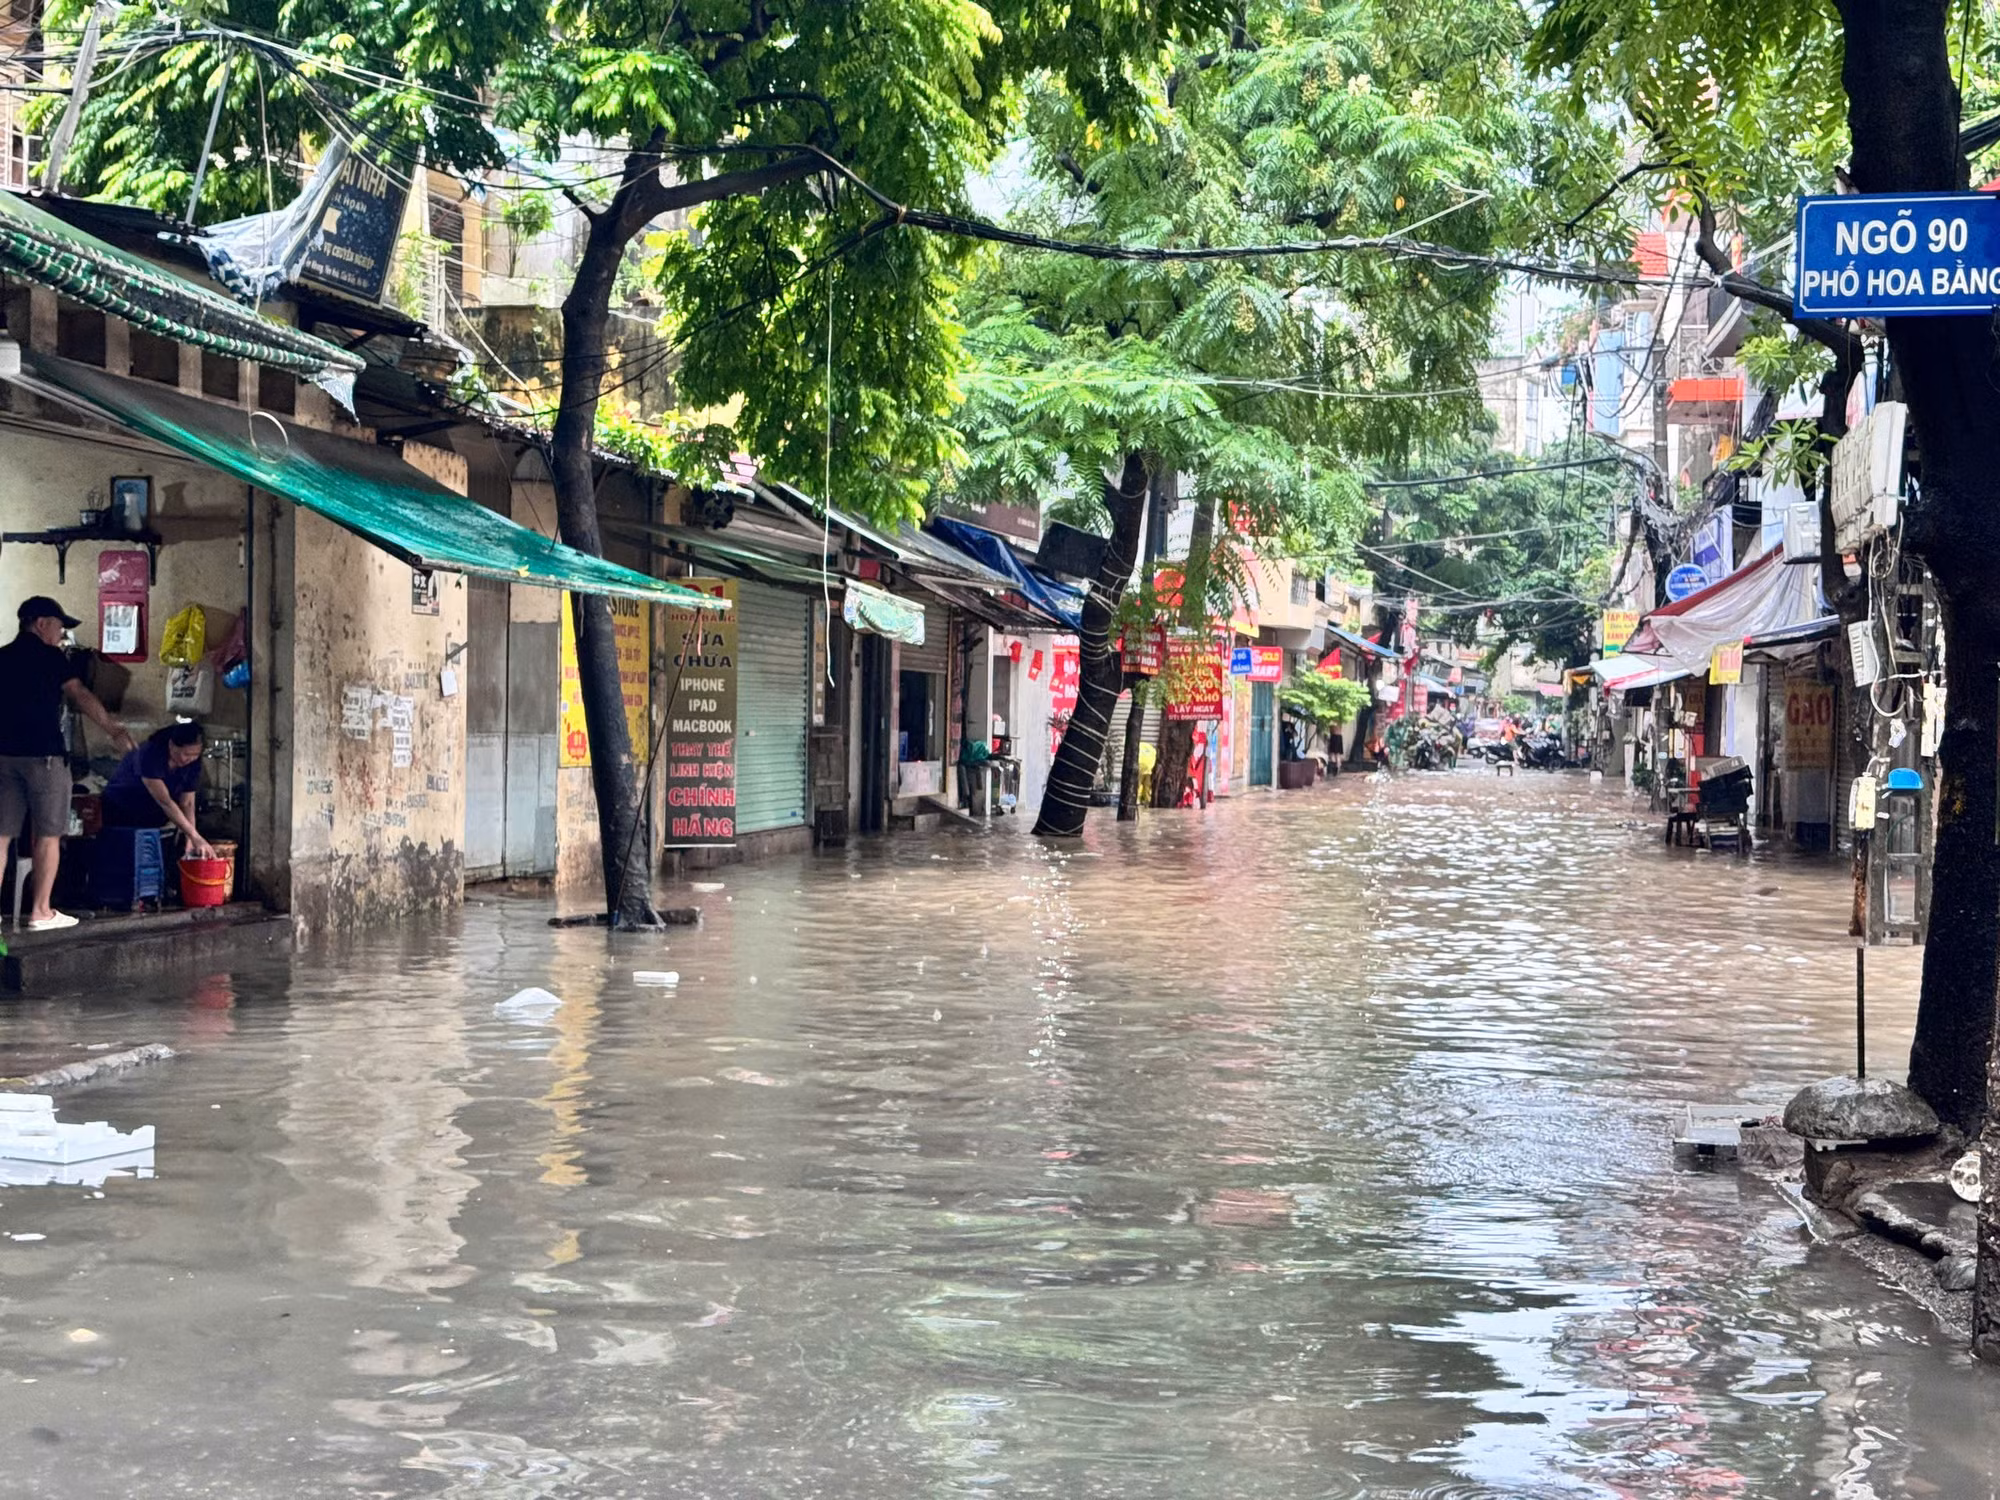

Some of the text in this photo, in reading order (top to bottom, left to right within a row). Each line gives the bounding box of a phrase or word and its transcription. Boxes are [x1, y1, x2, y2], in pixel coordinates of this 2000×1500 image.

[1836, 209, 1968, 255] NGÕ 90
[1803, 260, 1859, 297] PHỐ
[1867, 268, 1925, 296] HOA
[611, 596, 639, 618] STORE
[106, 630, 121, 642] 16
[674, 651, 732, 668] CHỮA
[681, 677, 725, 692] IPHONE
[688, 698, 718, 713] IPAD
[673, 718, 733, 733] MACBOOK
[671, 739, 735, 757] THAY THẾ
[670, 760, 735, 780] LINH HIỆN
[668, 782, 737, 807] CHÍNH
